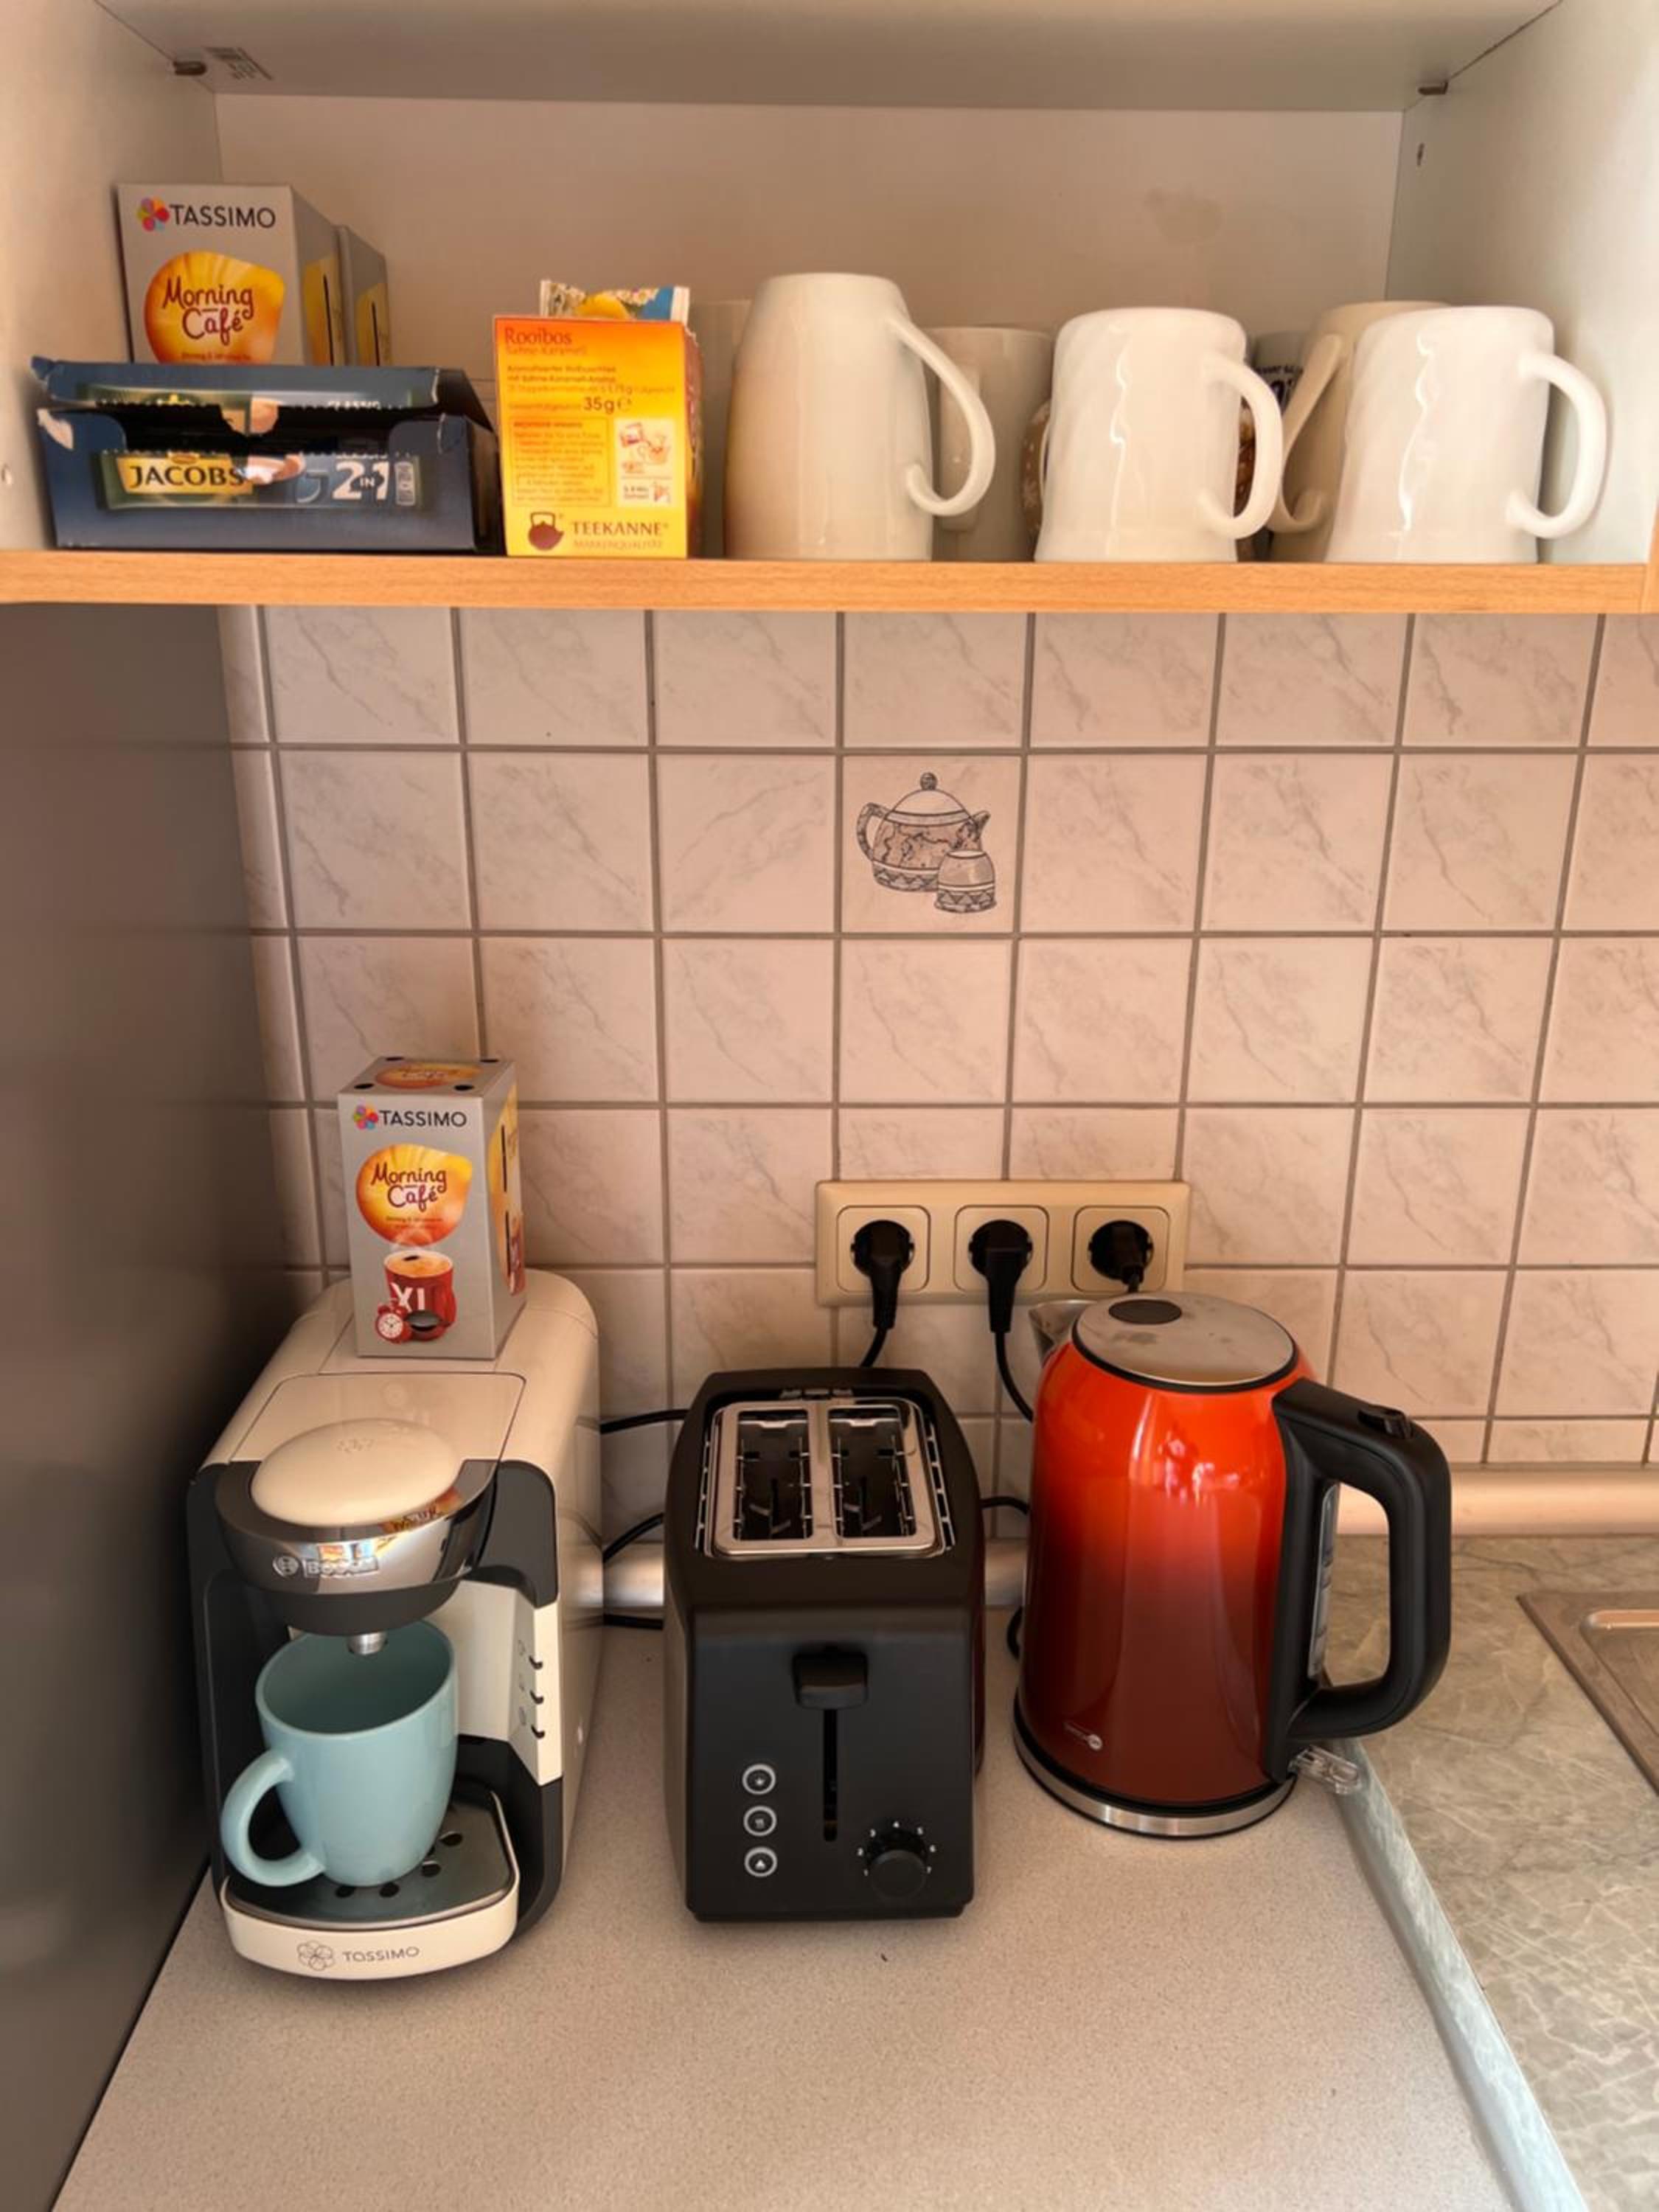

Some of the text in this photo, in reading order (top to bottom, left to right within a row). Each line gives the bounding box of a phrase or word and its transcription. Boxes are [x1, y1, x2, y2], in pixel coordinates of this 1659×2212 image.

[169, 204, 276, 229] TASSIMO
[162, 276, 254, 320] Morning
[182, 307, 244, 346] Café
[129, 465, 243, 489] JACOBS
[571, 521, 661, 536] TEEKANNE
[379, 1109, 467, 1127] TASSIMO
[370, 1161, 448, 1194] Morning
[387, 1183, 438, 1213] Café
